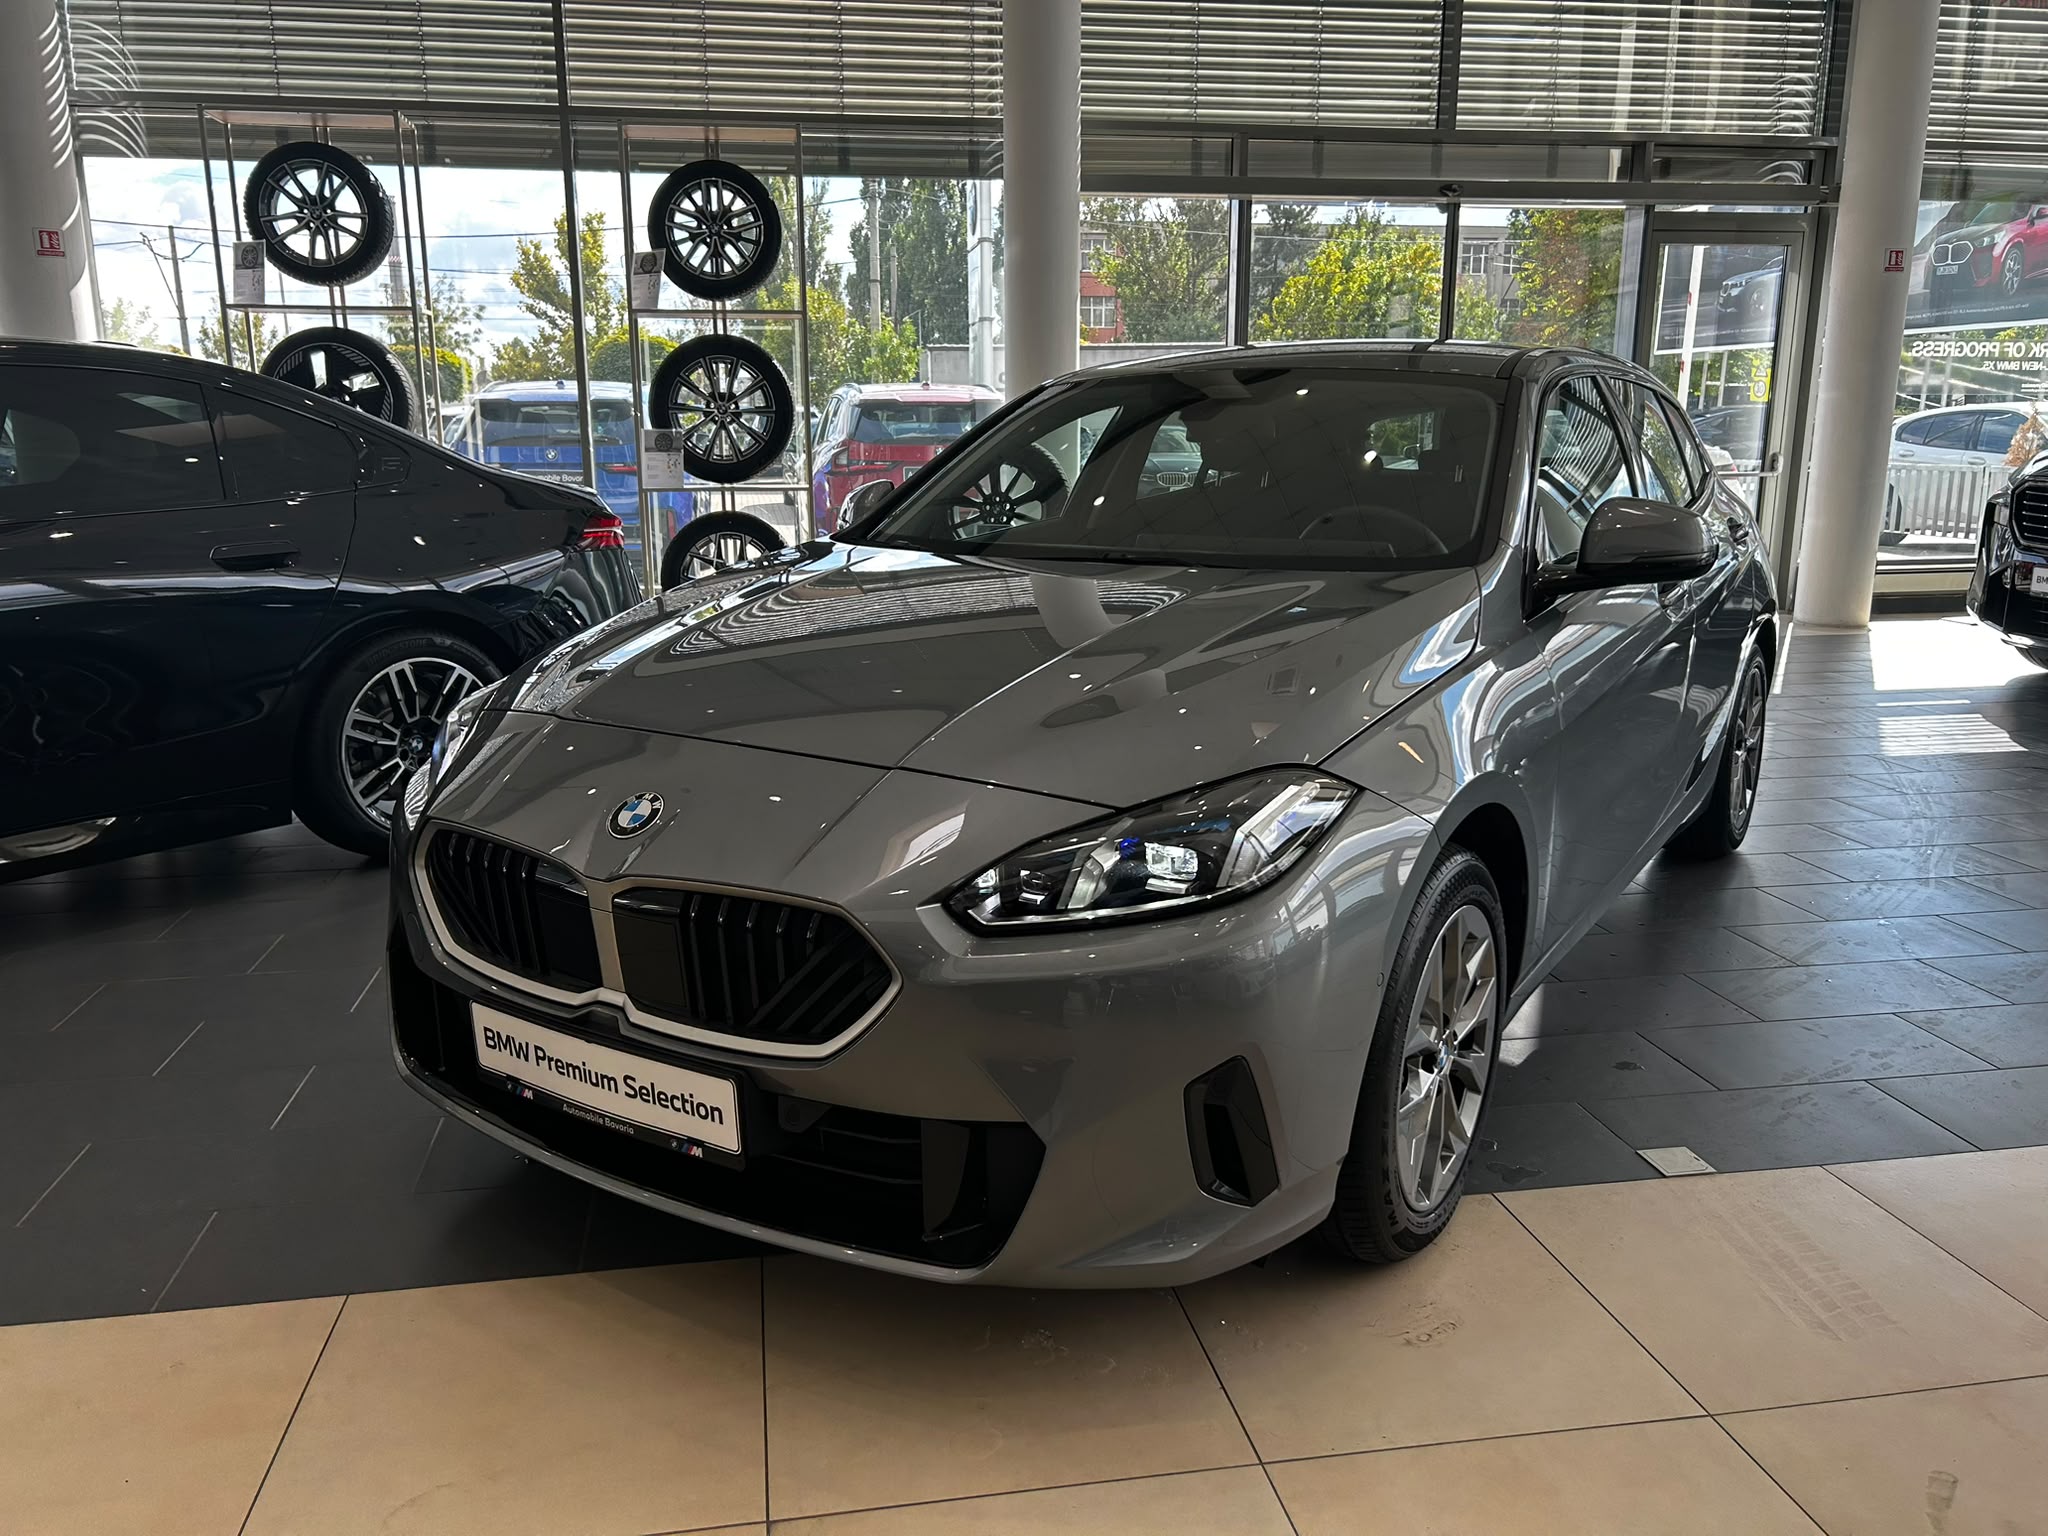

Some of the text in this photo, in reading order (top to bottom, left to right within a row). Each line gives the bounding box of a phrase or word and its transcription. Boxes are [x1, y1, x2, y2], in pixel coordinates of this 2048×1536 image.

[562, 473, 584, 482] Bavar
[2036, 575, 2048, 585] BM
[483, 1026, 724, 1125] BMW Premium Selection
[562, 1103, 635, 1135] Automobile Bavaria
